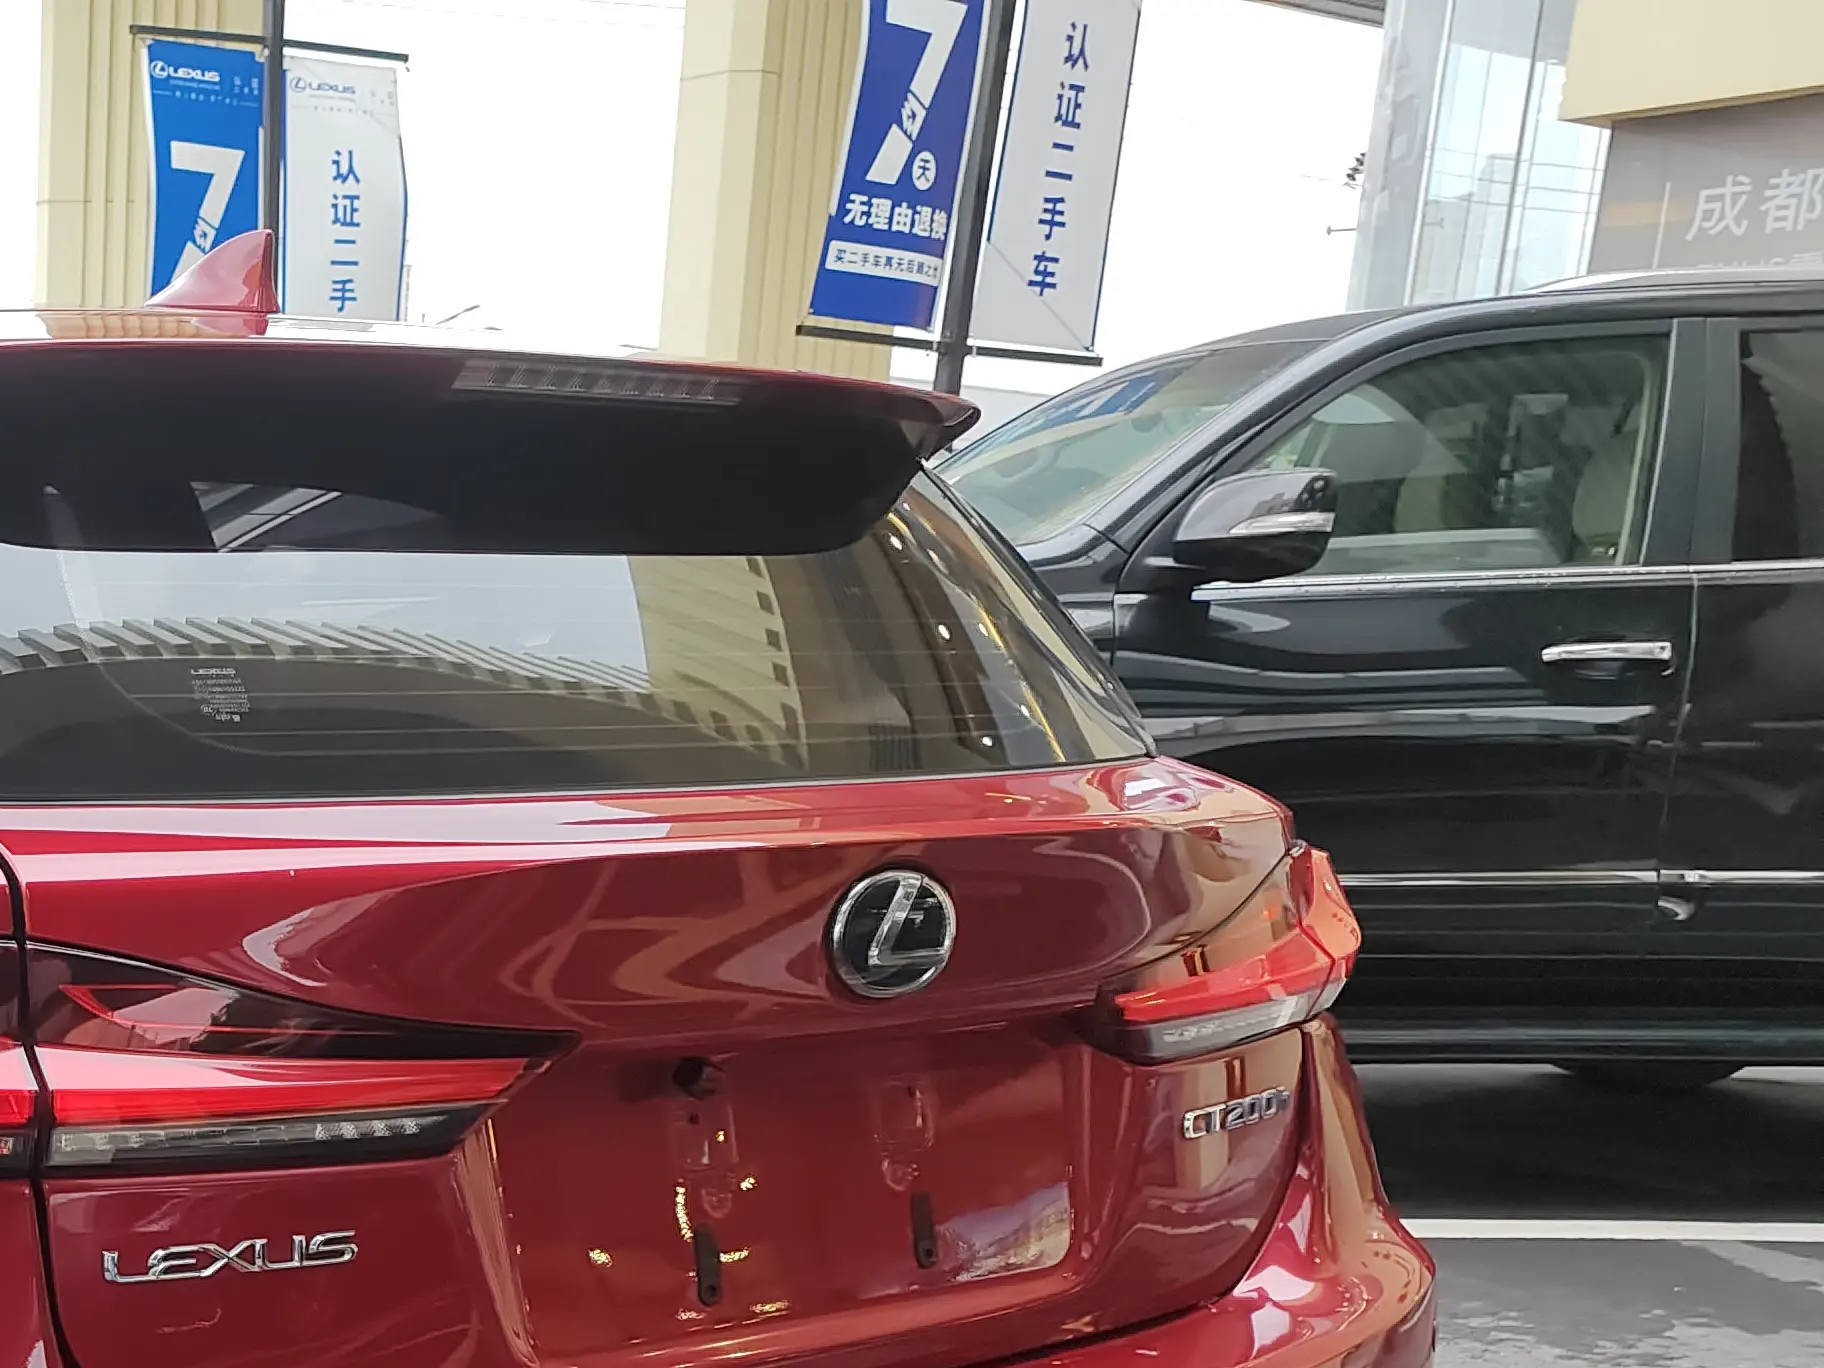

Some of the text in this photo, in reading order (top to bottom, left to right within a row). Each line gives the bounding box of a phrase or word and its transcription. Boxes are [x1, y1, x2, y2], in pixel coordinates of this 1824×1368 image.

[169, 66, 221, 82] LEXUS
[308, 82, 356, 94] LEXUS
[1027, 22, 1090, 296] 认证二手车
[329, 149, 361, 313] 认证二手
[843, 193, 947, 240] 无理由退换
[1685, 168, 1824, 241] 成都
[101, 1229, 359, 1284] LEXUS
